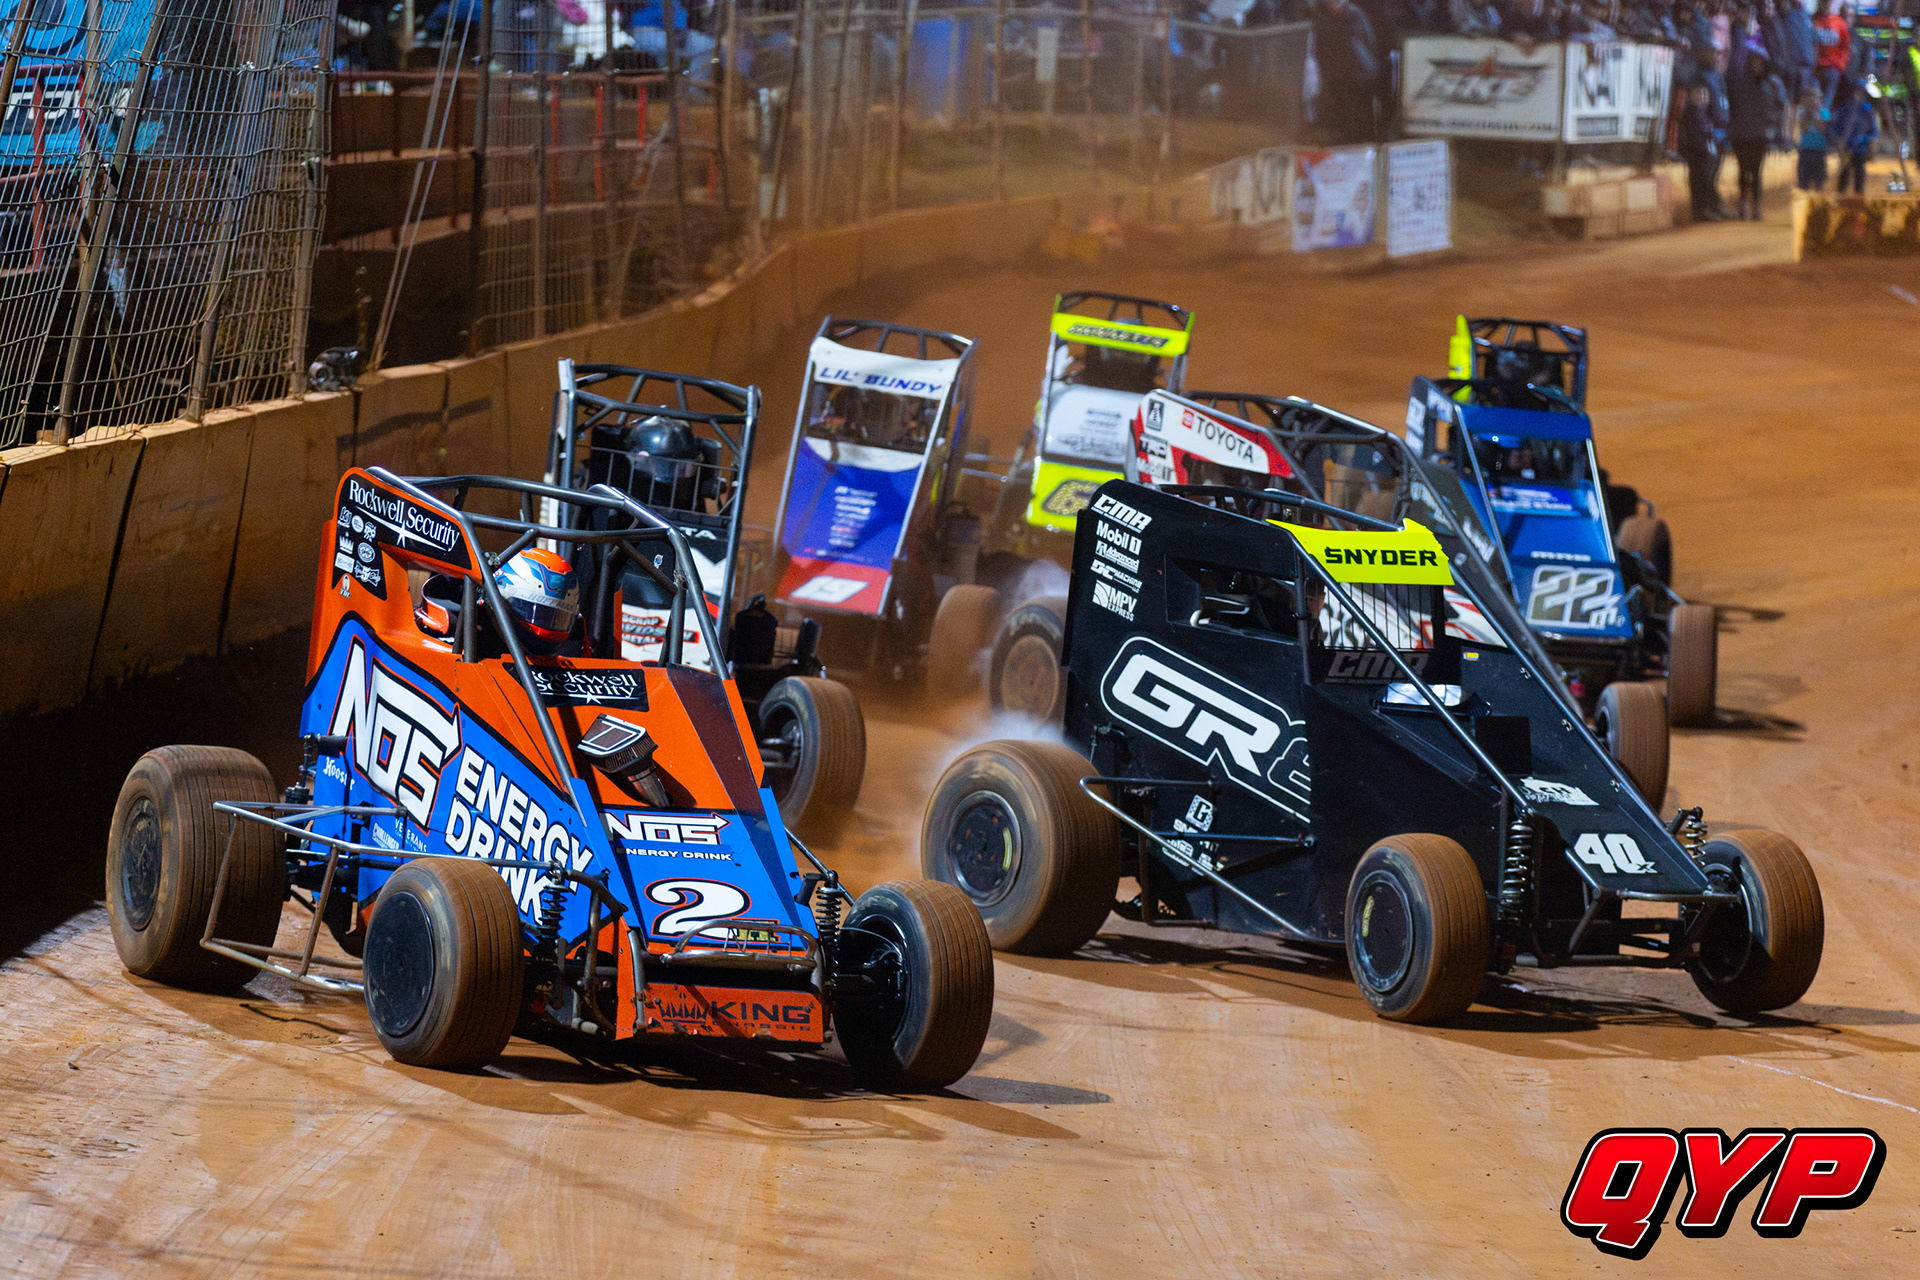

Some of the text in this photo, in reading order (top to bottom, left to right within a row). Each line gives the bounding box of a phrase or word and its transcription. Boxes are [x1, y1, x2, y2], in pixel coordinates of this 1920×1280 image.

[863, 373, 943, 394] BUNDY
[1197, 415, 1254, 464] TOYOTA
[349, 479, 405, 524] Rockwell
[404, 506, 460, 552] Security
[1096, 520, 1142, 556] Mobil 1
[1324, 547, 1439, 567] SNYDER
[1108, 602, 1135, 621] EXPRESS
[1110, 587, 1137, 613] MPV
[331, 641, 462, 829] NOS
[322, 756, 356, 791] Hoosir
[394, 817, 428, 853] VEERANS
[455, 745, 594, 894] ENERGY
[604, 812, 731, 846] NOS
[444, 796, 550, 926] DRINK
[682, 850, 732, 861] DRINK
[648, 879, 752, 943] 2
[710, 1000, 812, 1025] KING
